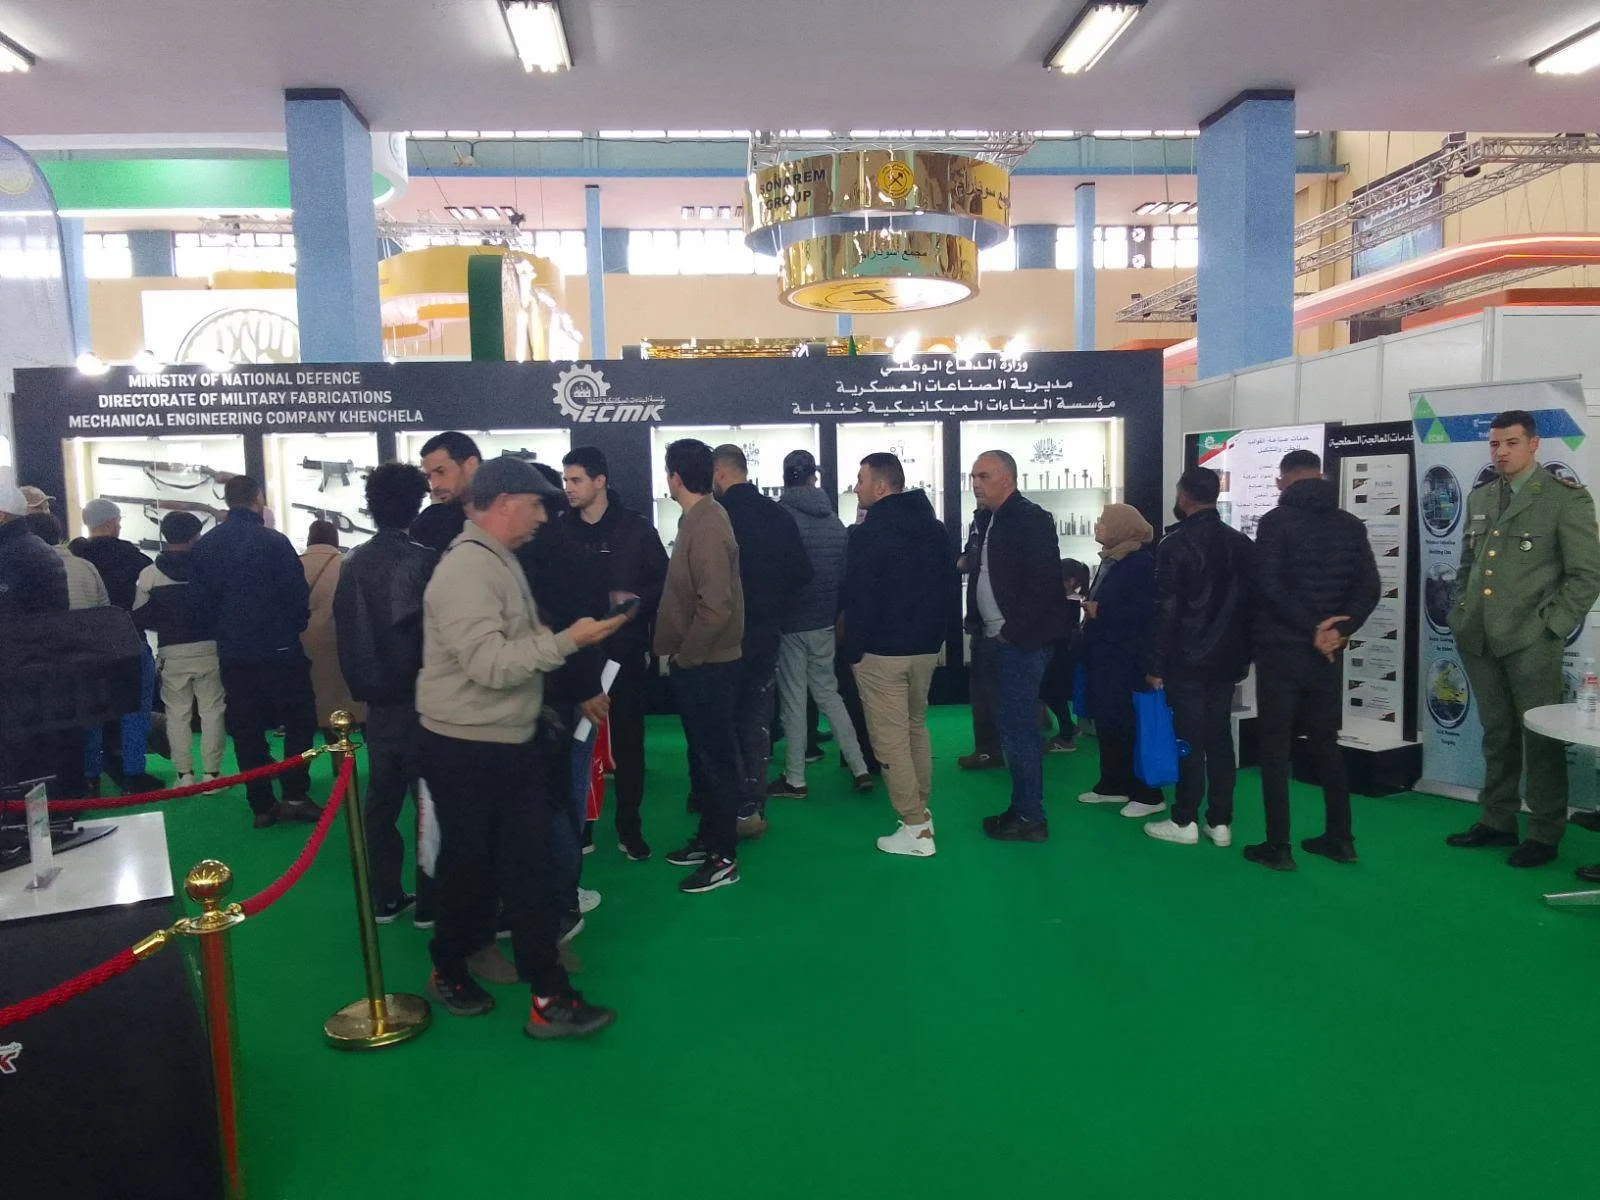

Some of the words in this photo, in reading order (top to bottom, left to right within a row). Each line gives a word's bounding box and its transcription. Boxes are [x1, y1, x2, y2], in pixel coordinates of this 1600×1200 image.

[760, 169, 826, 194] SONAREM
[766, 190, 811, 210] GROUP
[880, 360, 942, 377] الوطني
[945, 359, 996, 374] الدفاع
[1000, 358, 1029, 373] وزارة
[128, 373, 197, 388] MINISTRY
[200, 373, 219, 387] OF
[222, 372, 294, 387] NATIONAL
[296, 371, 361, 385] DEFENCE
[835, 379, 922, 397] العسكرية
[925, 378, 1007, 393] الصناعات
[1010, 378, 1073, 393] مديرية
[98, 393, 196, 408] DIRECTORATE
[199, 393, 218, 406] OF
[221, 391, 286, 406] MILITARY
[290, 390, 392, 404] FABRICATIONS
[986, 397, 1052, 414] البناءات
[1056, 395, 1116, 413] مؤسسة
[792, 402, 864, 415] خنشلة
[867, 399, 983, 417] الميكانيكية
[69, 413, 164, 428] MECHANICAL
[167, 411, 263, 427] ENGINEERING
[266, 410, 336, 425] COMPANY
[339, 409, 424, 424] KHENCHELA
[1328, 434, 1362, 449] السطحية
[1361, 433, 1390, 446] المعالجة
